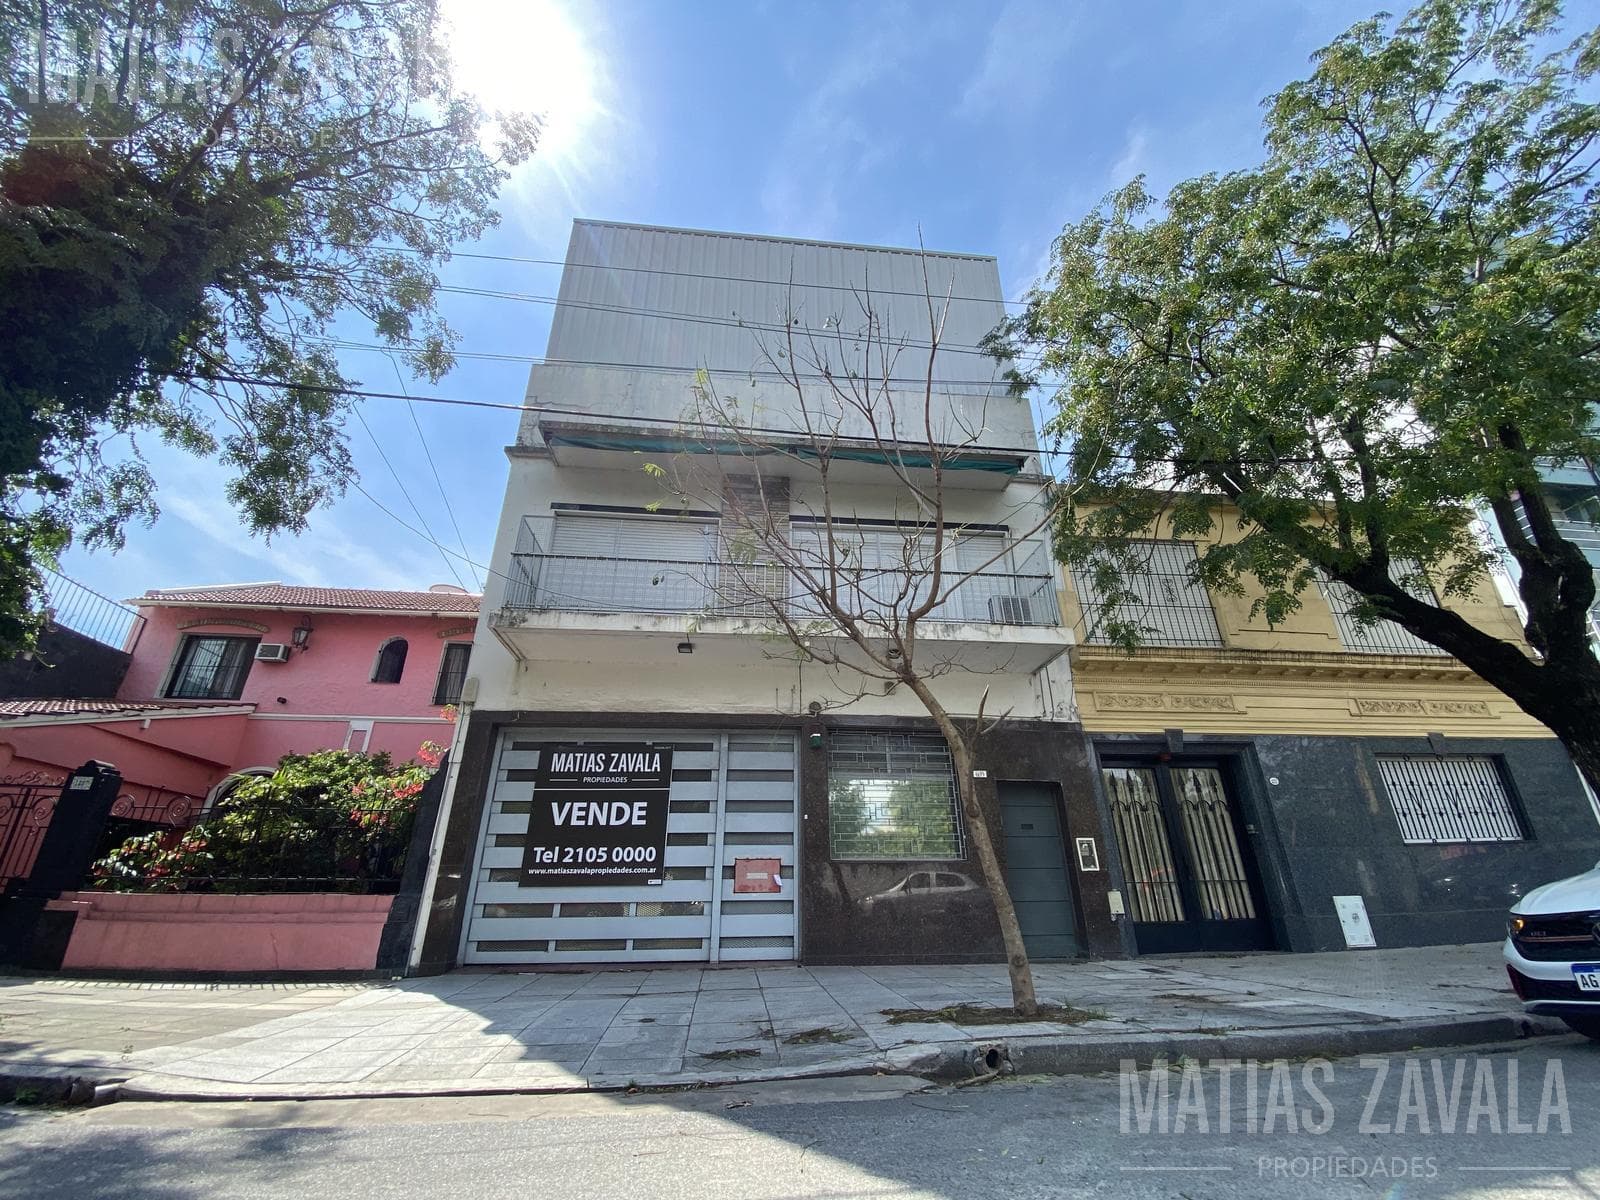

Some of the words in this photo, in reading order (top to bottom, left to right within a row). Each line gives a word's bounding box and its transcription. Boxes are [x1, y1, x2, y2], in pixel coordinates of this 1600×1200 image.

[551, 753, 605, 773] MATIAS
[608, 753, 660, 773] ZAVALA
[551, 802, 647, 825] VENDE
[533, 846, 559, 862] Tel
[562, 847, 607, 862] 2105
[612, 847, 656, 862] 0000
[528, 867, 656, 875] www.matiaszavalapropiedades.com.ar
[1580, 974, 1600, 988] AG
